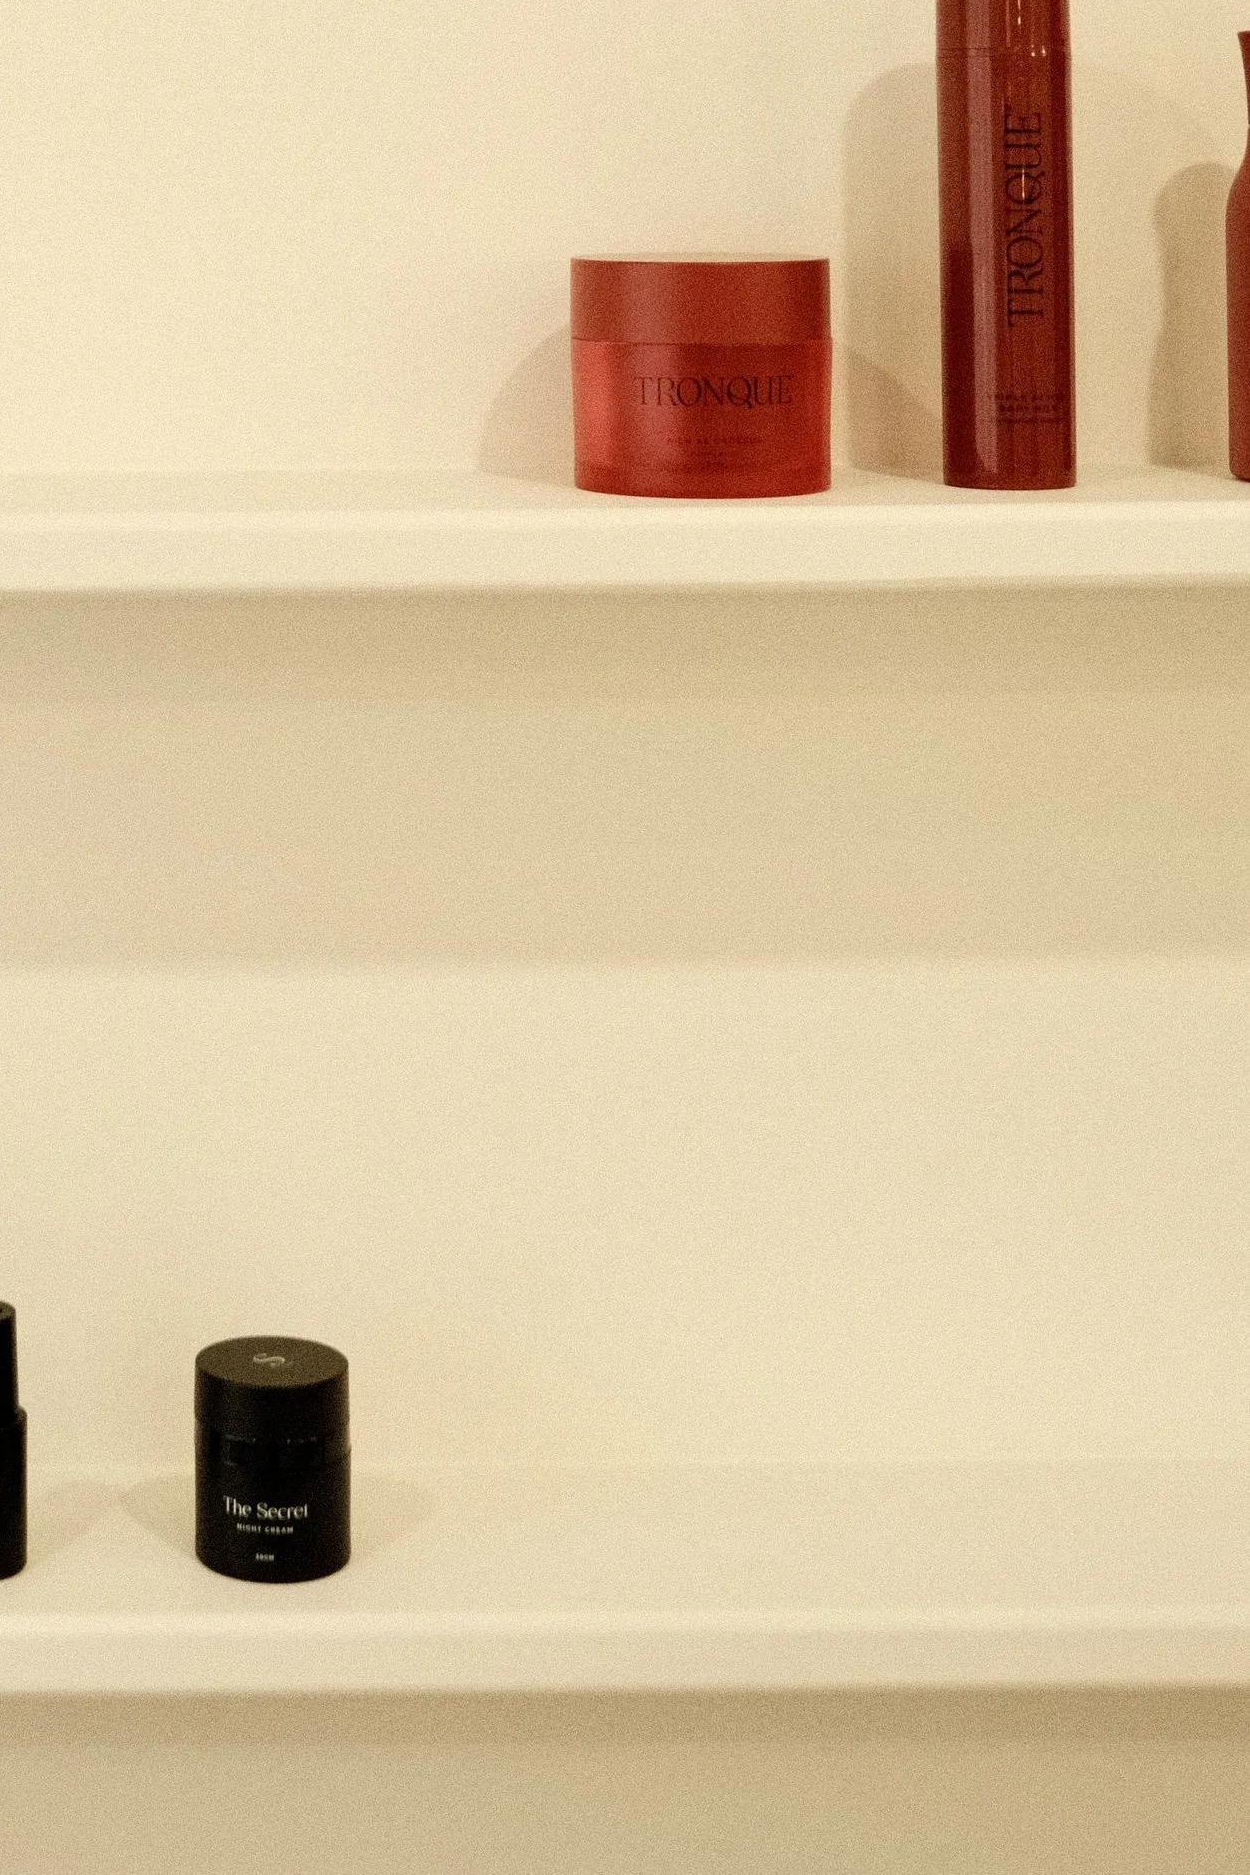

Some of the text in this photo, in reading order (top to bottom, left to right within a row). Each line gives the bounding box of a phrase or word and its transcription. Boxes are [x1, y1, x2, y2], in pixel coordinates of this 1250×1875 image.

[1004, 111, 1043, 329] TRONQUE
[633, 375, 795, 410] TRONQUE
[223, 1495, 308, 1520] The Secret
